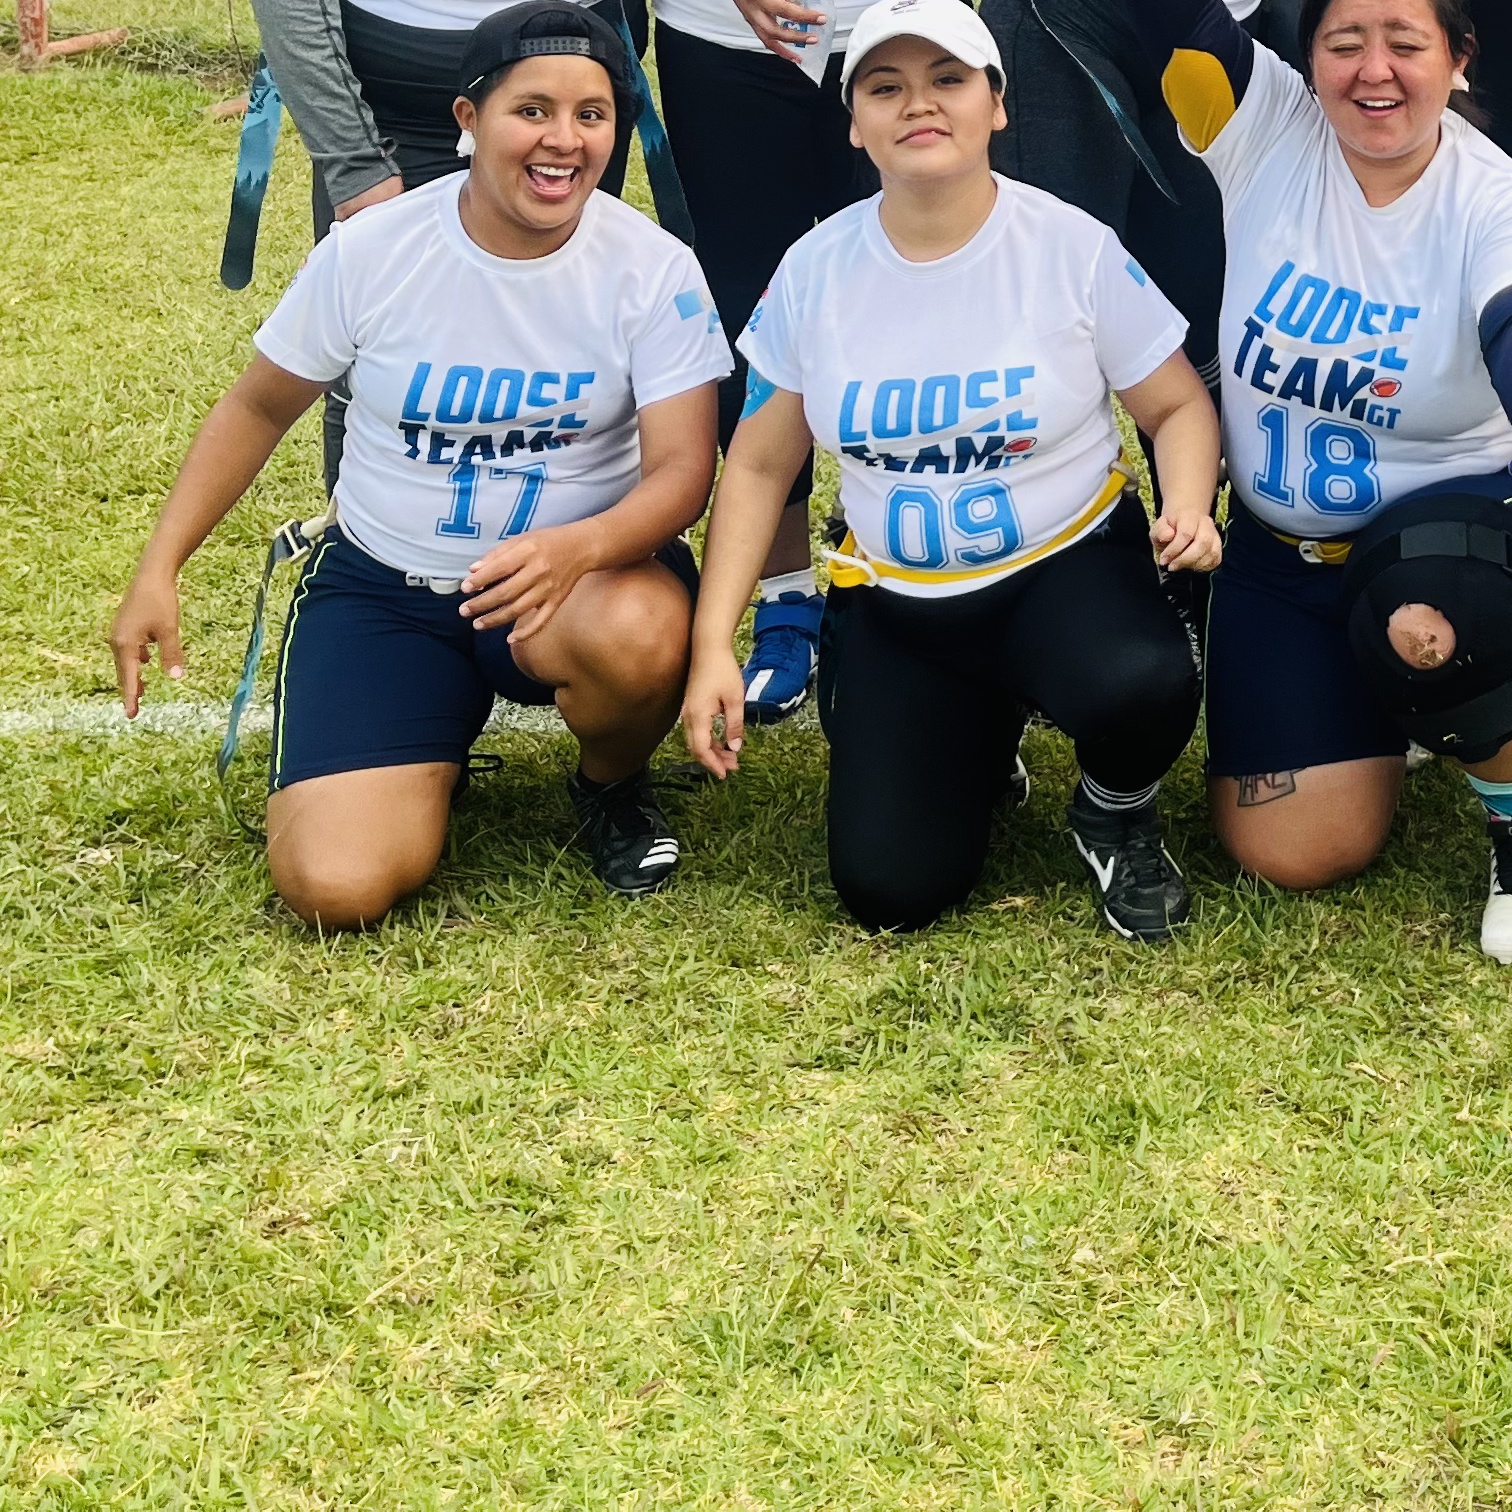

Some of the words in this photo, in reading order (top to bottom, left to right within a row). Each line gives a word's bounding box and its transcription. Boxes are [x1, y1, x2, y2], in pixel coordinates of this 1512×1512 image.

[1254, 259, 1420, 371] LOOSE
[401, 362, 596, 428] LOOSE
[838, 365, 1038, 443] LOOSE
[1233, 316, 1375, 421] TEAM
[436, 461, 548, 540] 17
[1253, 402, 1382, 516] 18
[884, 478, 1024, 569] 09
